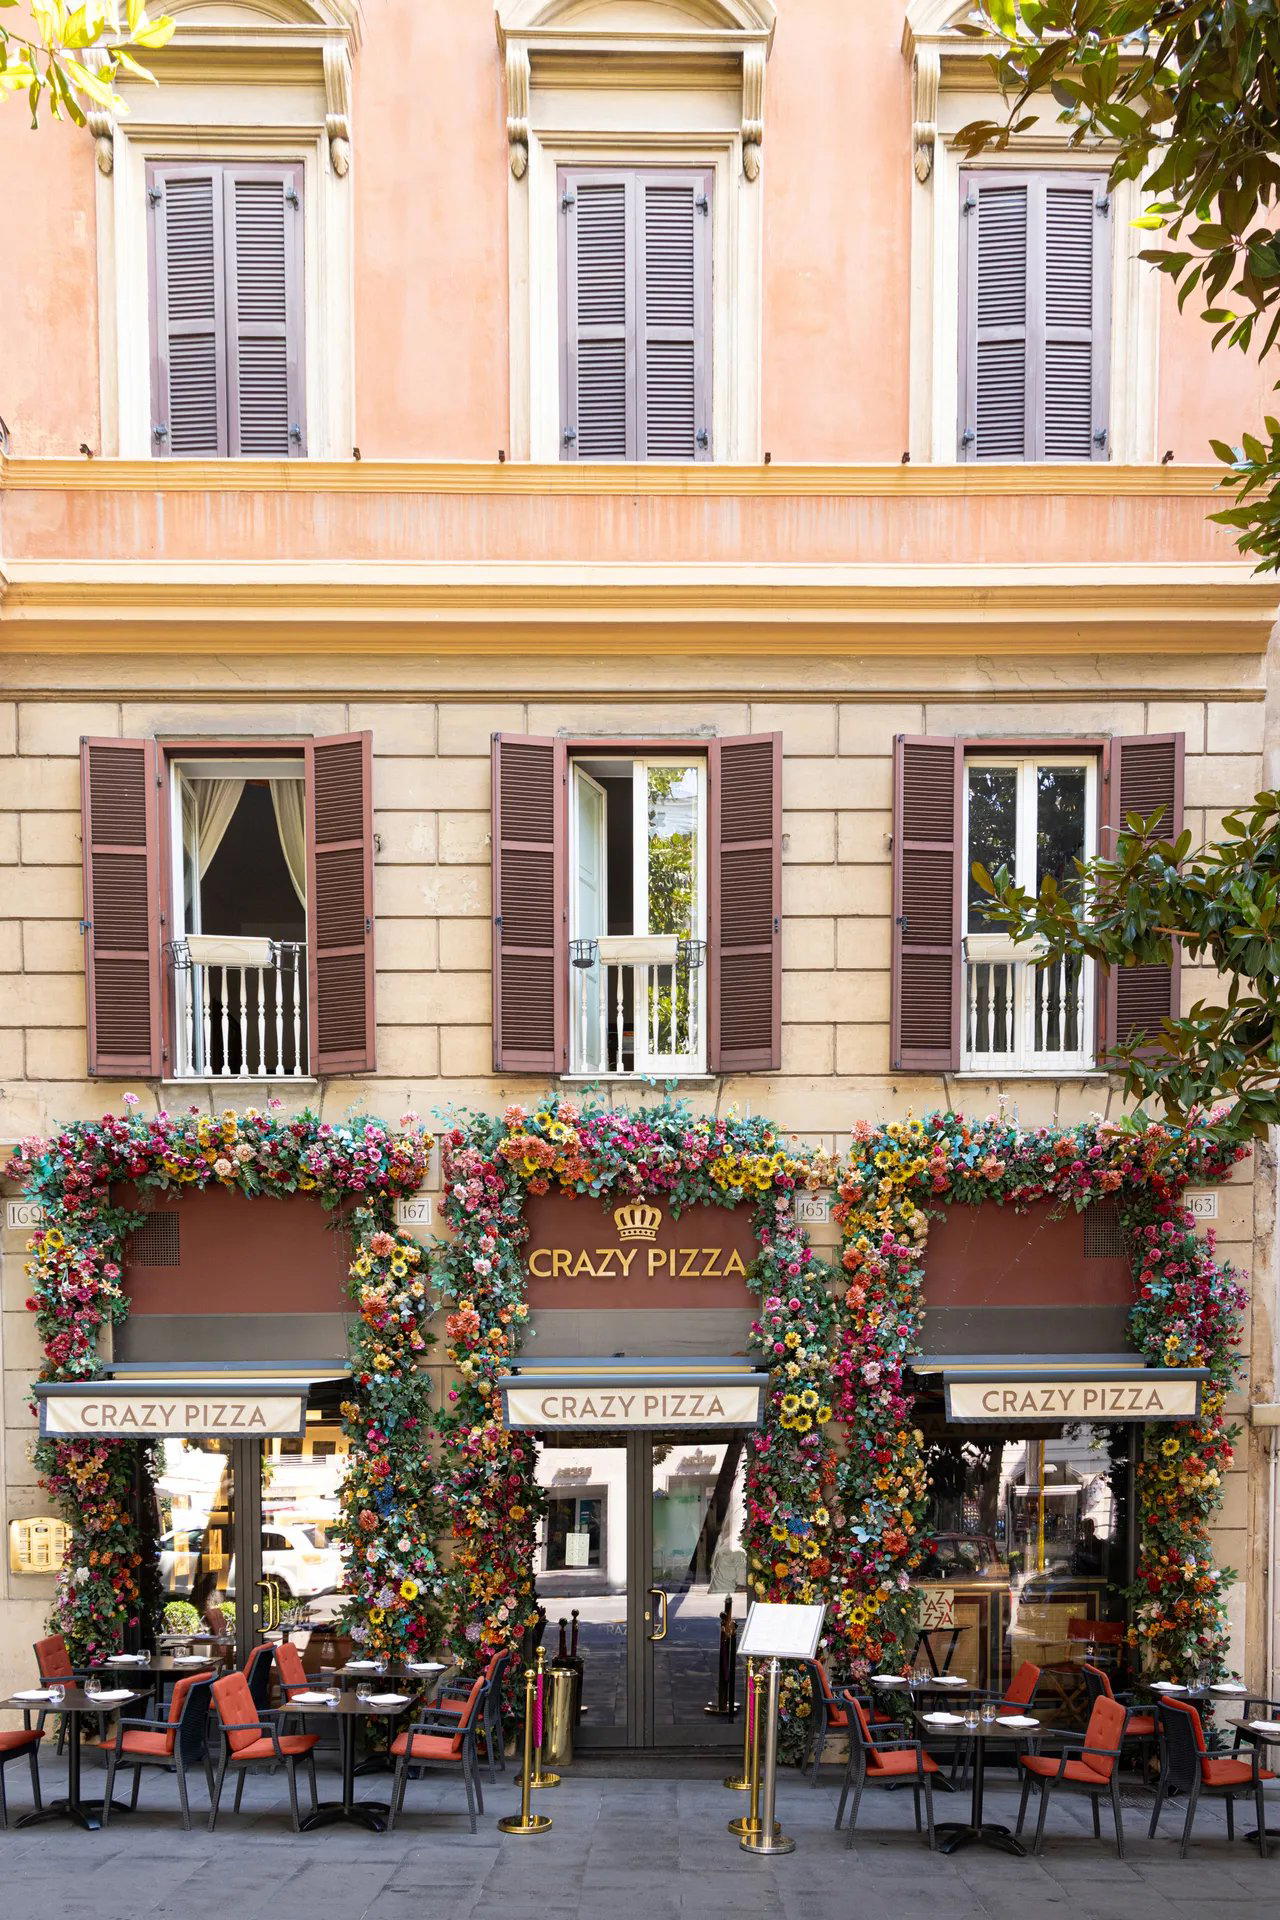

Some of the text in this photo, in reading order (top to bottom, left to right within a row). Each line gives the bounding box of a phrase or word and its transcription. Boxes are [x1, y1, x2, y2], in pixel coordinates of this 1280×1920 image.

[12, 1205, 42, 1224] 169
[402, 1204, 426, 1219] 167
[800, 1202, 824, 1217] 165
[1189, 1198, 1212, 1213] 163
[528, 1248, 747, 1277] CRAZY PIZZA
[541, 1394, 725, 1419] CRAZY PIZZA
[982, 1387, 1164, 1413] CRAZY PIZZA
[80, 1404, 267, 1427] CRAZY PIZZA
